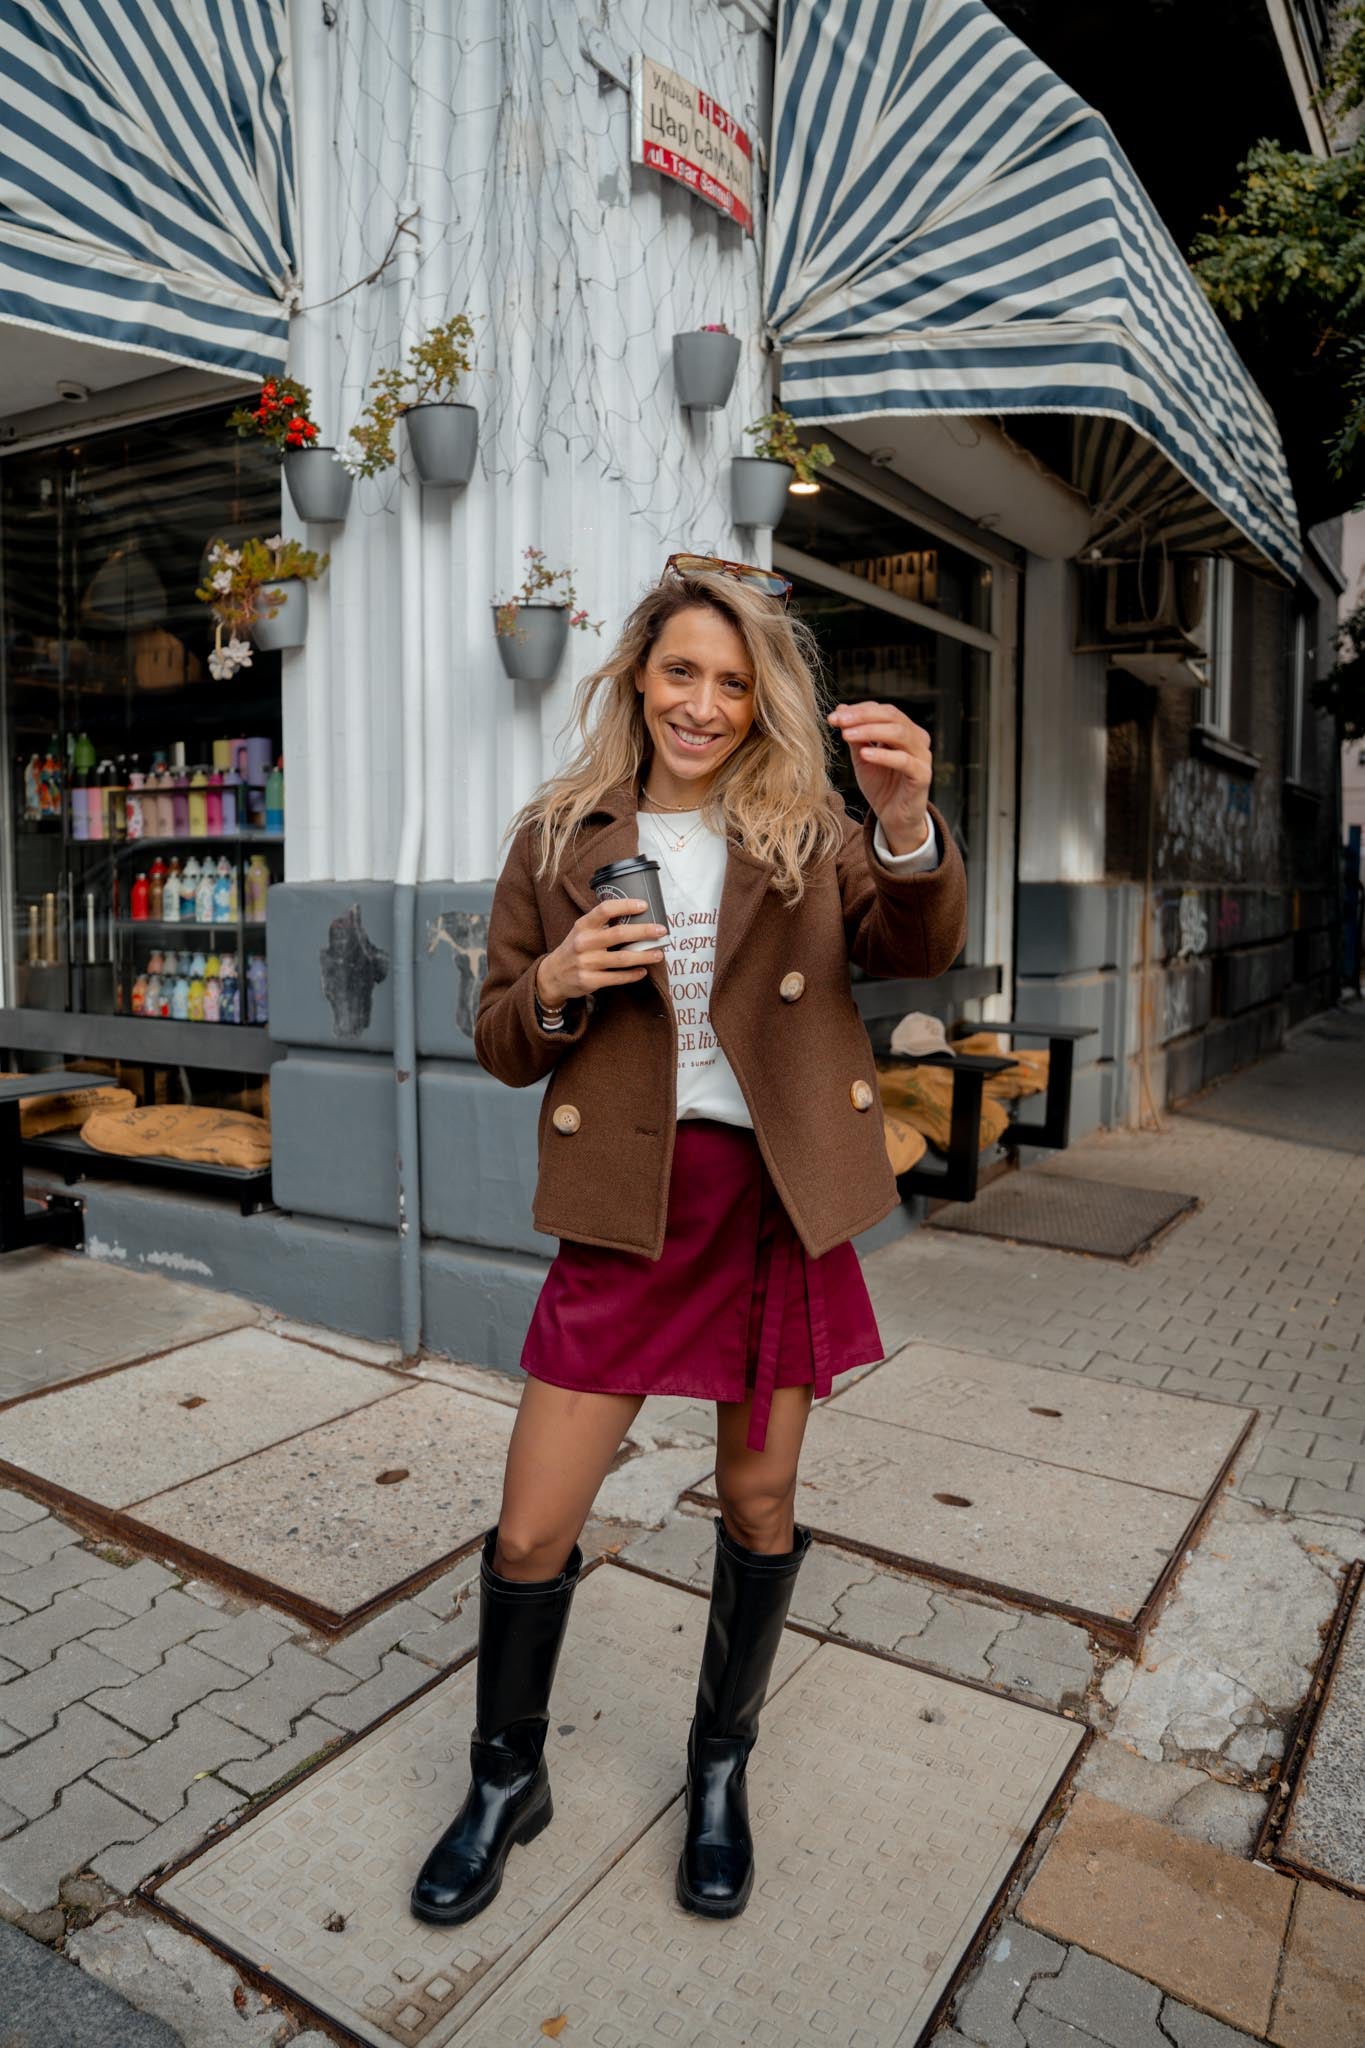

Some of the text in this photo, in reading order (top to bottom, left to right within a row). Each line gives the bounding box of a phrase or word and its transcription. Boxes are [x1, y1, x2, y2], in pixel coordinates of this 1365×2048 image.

[652, 71, 692, 109] Улица
[700, 92, 715, 123] 11
[650, 103, 688, 145] Цар
[670, 153, 700, 183] Tsar
[666, 908, 718, 928] NG sunl
[679, 936, 717, 953] espre
[666, 958, 688, 976] MY
[698, 1030, 721, 1049] liv
